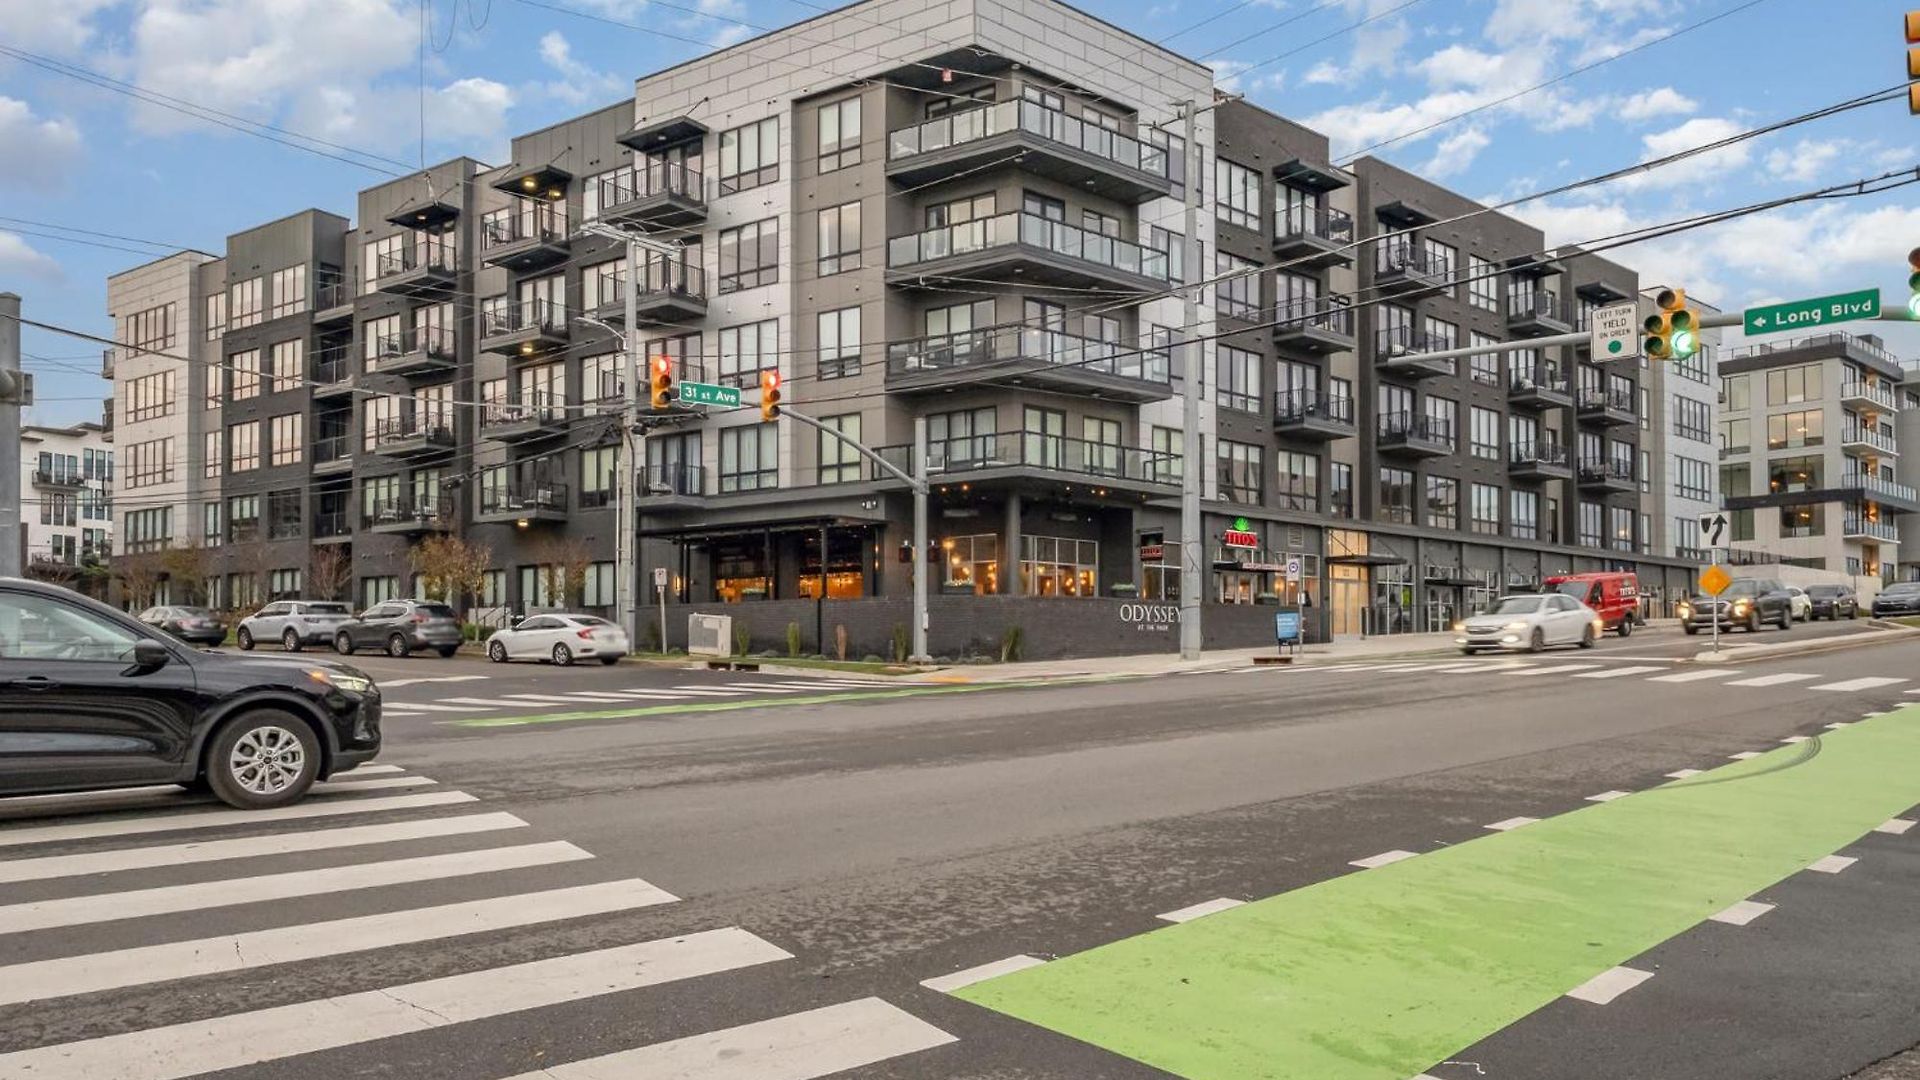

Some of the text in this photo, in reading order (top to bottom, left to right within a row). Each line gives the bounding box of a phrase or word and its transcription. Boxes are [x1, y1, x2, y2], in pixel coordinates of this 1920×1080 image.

[1596, 310, 1612, 319] LEFT
[1775, 299, 1871, 325] Long Blvd
[1603, 317, 1627, 329] YIELD
[1610, 328, 1630, 337] GREEN
[685, 386, 697, 399] 31
[716, 390, 737, 403] Ave
[1120, 604, 1181, 623] ODYSSEY
